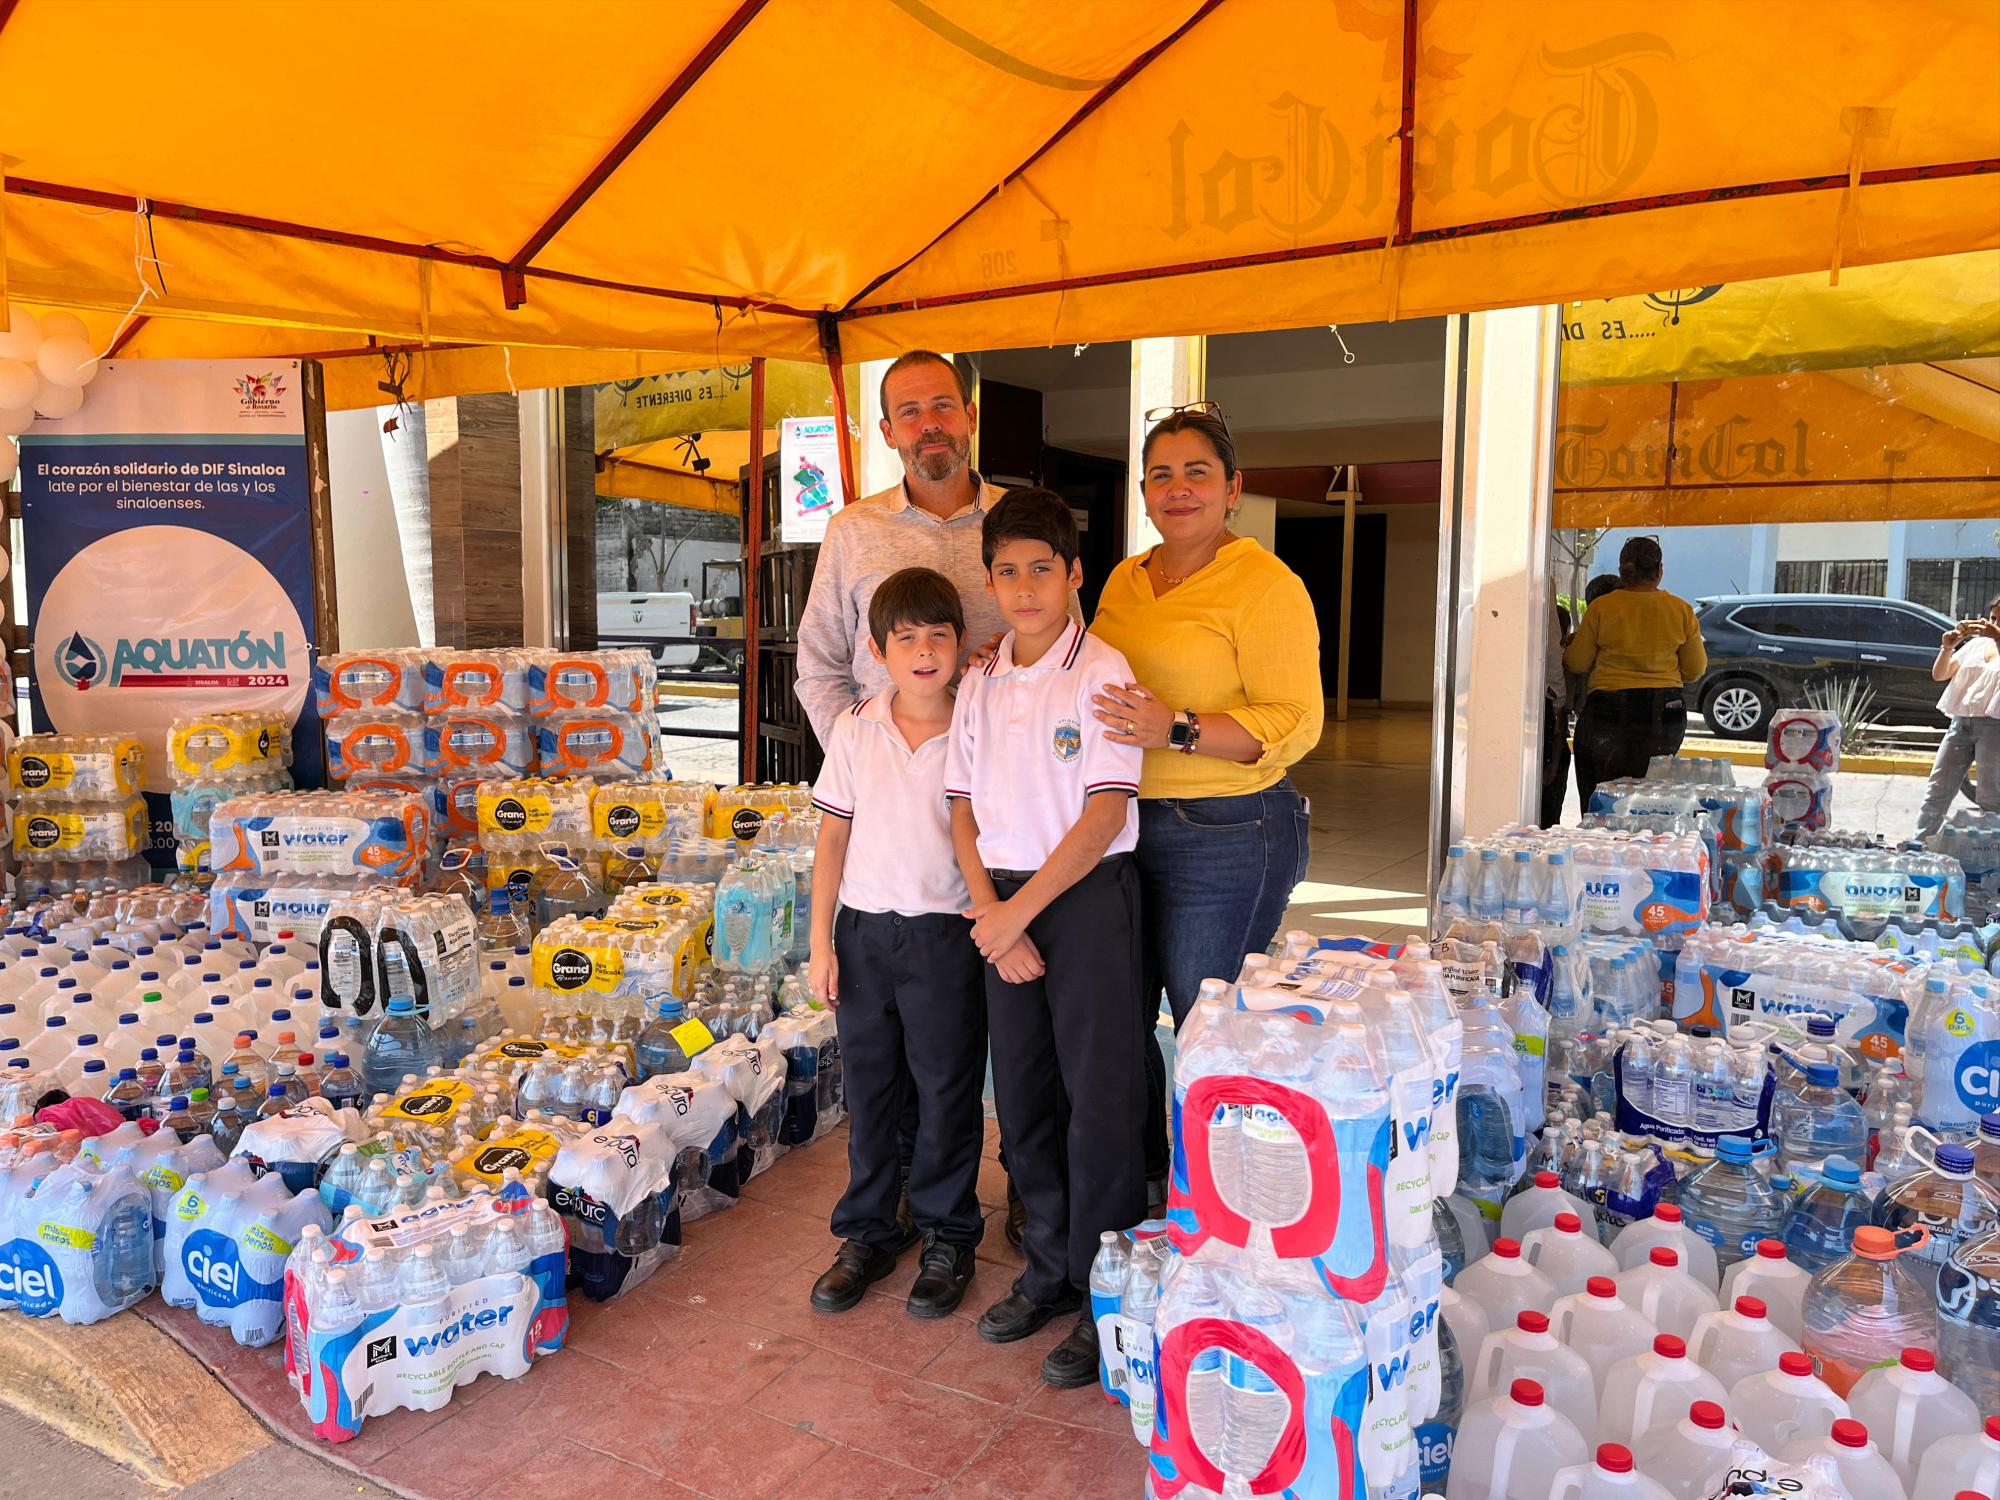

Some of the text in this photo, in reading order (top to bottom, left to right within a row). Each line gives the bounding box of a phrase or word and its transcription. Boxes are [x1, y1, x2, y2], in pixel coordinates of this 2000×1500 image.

[37, 462, 286, 476] El corazón solidario de DIF Sinaloa
[48, 479, 276, 496] late por el bienestar de las y los
[116, 496, 205, 509] sinaloenses.
[109, 630, 287, 687] AQUATÓN
[248, 675, 285, 686] 2024
[155, 821, 173, 832] 20
[609, 816, 639, 825] Grand
[733, 820, 763, 829] Grand
[28, 829, 58, 838] Grand
[367, 846, 381, 854] 45
[1648, 905, 1665, 917] 45
[552, 963, 590, 974] Grand
[1954, 1012, 1966, 1024] 6
[1948, 1023, 1971, 1032] pack
[1870, 1034, 1888, 1049] 45
[587, 1108, 596, 1121] 6
[1640, 1122, 1685, 1135] Agua Purificada
[187, 1194, 200, 1208] 6
[0, 1252, 56, 1299] ciel
[187, 1244, 239, 1297] ciel
[439, 1297, 489, 1325] PURIFIED
[403, 1304, 514, 1358] water
[1417, 1360, 1431, 1372] CAP
[396, 1366, 446, 1380] RECYCLABLE
